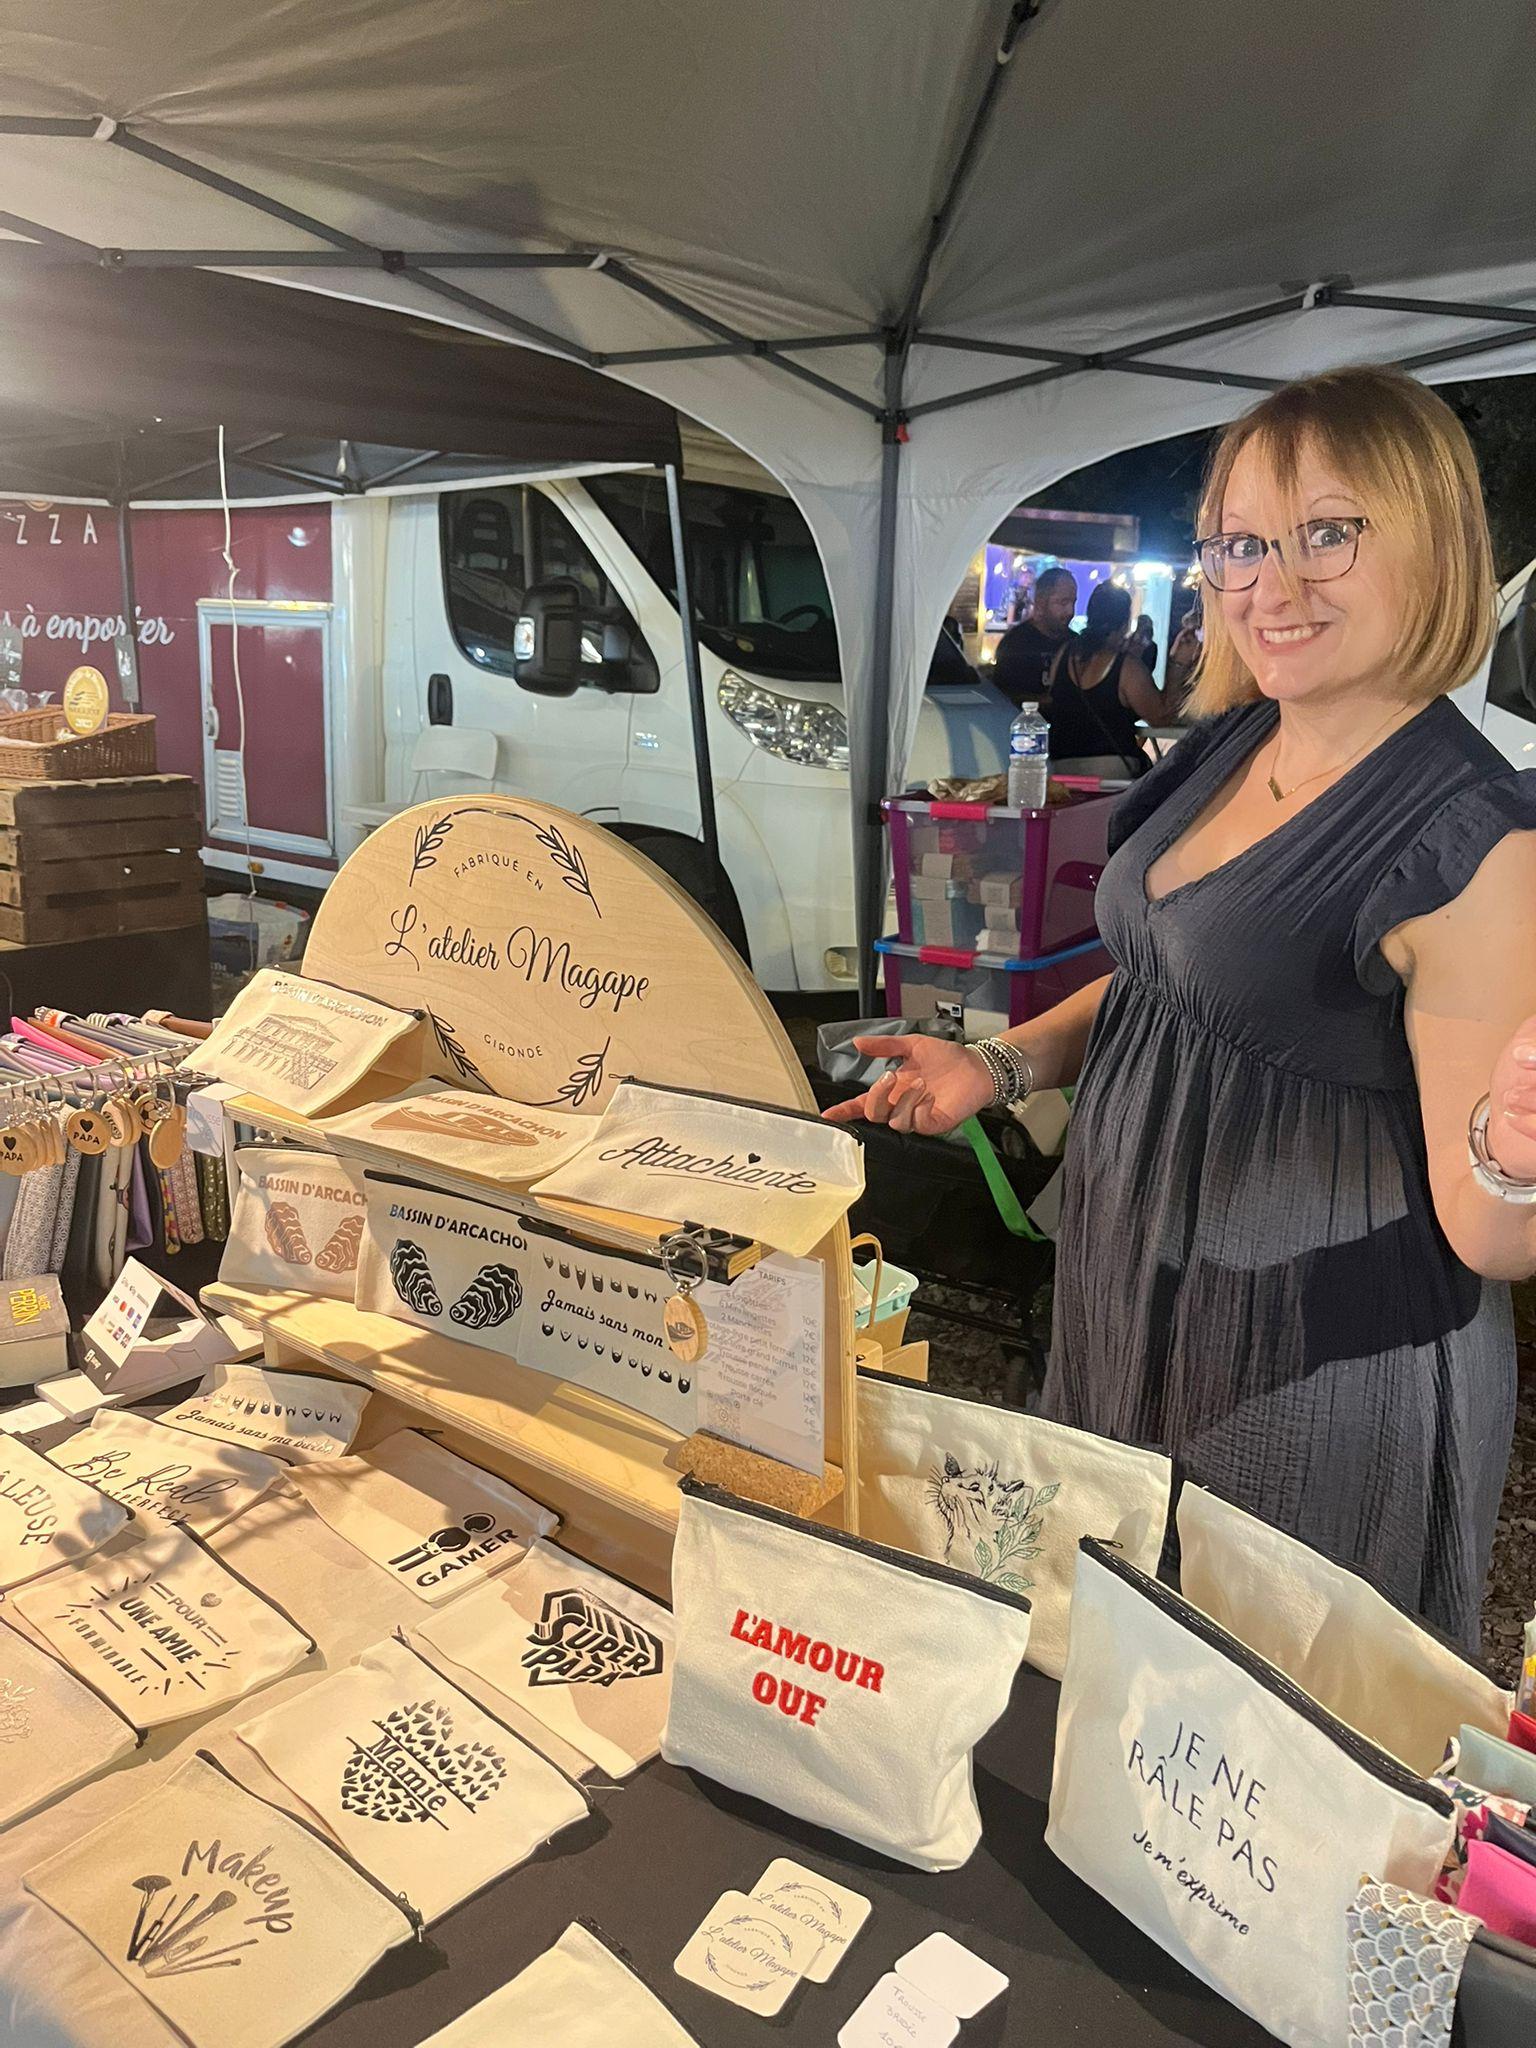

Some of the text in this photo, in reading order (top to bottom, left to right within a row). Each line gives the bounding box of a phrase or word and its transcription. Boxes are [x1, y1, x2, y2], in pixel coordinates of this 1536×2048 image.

[453, 852, 544, 891] FABRIQUÉ EN
[384, 904, 649, 1013] L'atelier Magape
[483, 1034, 543, 1059] GIRONDE
[73, 1132, 101, 1145] PAPA
[466, 1103, 568, 1140] D'ARCACHON
[258, 1175, 299, 1195] BASSIN
[598, 1136, 818, 1194] Attachiante
[389, 1204, 433, 1226] BASSIN
[541, 1289, 664, 1348] Jamais sans mon
[176, 1409, 237, 1432] Jamais
[236, 1425, 268, 1440] sans
[268, 1434, 292, 1446] ma
[62, 1450, 131, 1479] Be
[122, 1464, 240, 1504] Real
[0, 1470, 59, 1545] LEUSE
[416, 1528, 519, 1588] GAMER
[119, 1596, 202, 1664] UNE AMIE
[168, 1597, 208, 1630] POUR
[521, 1646, 623, 1688] PAPA
[525, 1613, 651, 1671] SUPER
[730, 1608, 885, 1694] L'AMOUR
[752, 1671, 828, 1727] OUF
[365, 1734, 448, 1811] Mamie
[1169, 1721, 1266, 1820] JE NE
[1128, 1739, 1279, 1893] RÂLE PAS
[1132, 1830, 1153, 1854] Je
[181, 1838, 294, 1934] Makeup
[752, 1892, 797, 1920] L'atelier
[799, 1914, 848, 1945] Magape
[701, 1925, 747, 1954] L'atelier
[749, 1947, 798, 1978] Magape
